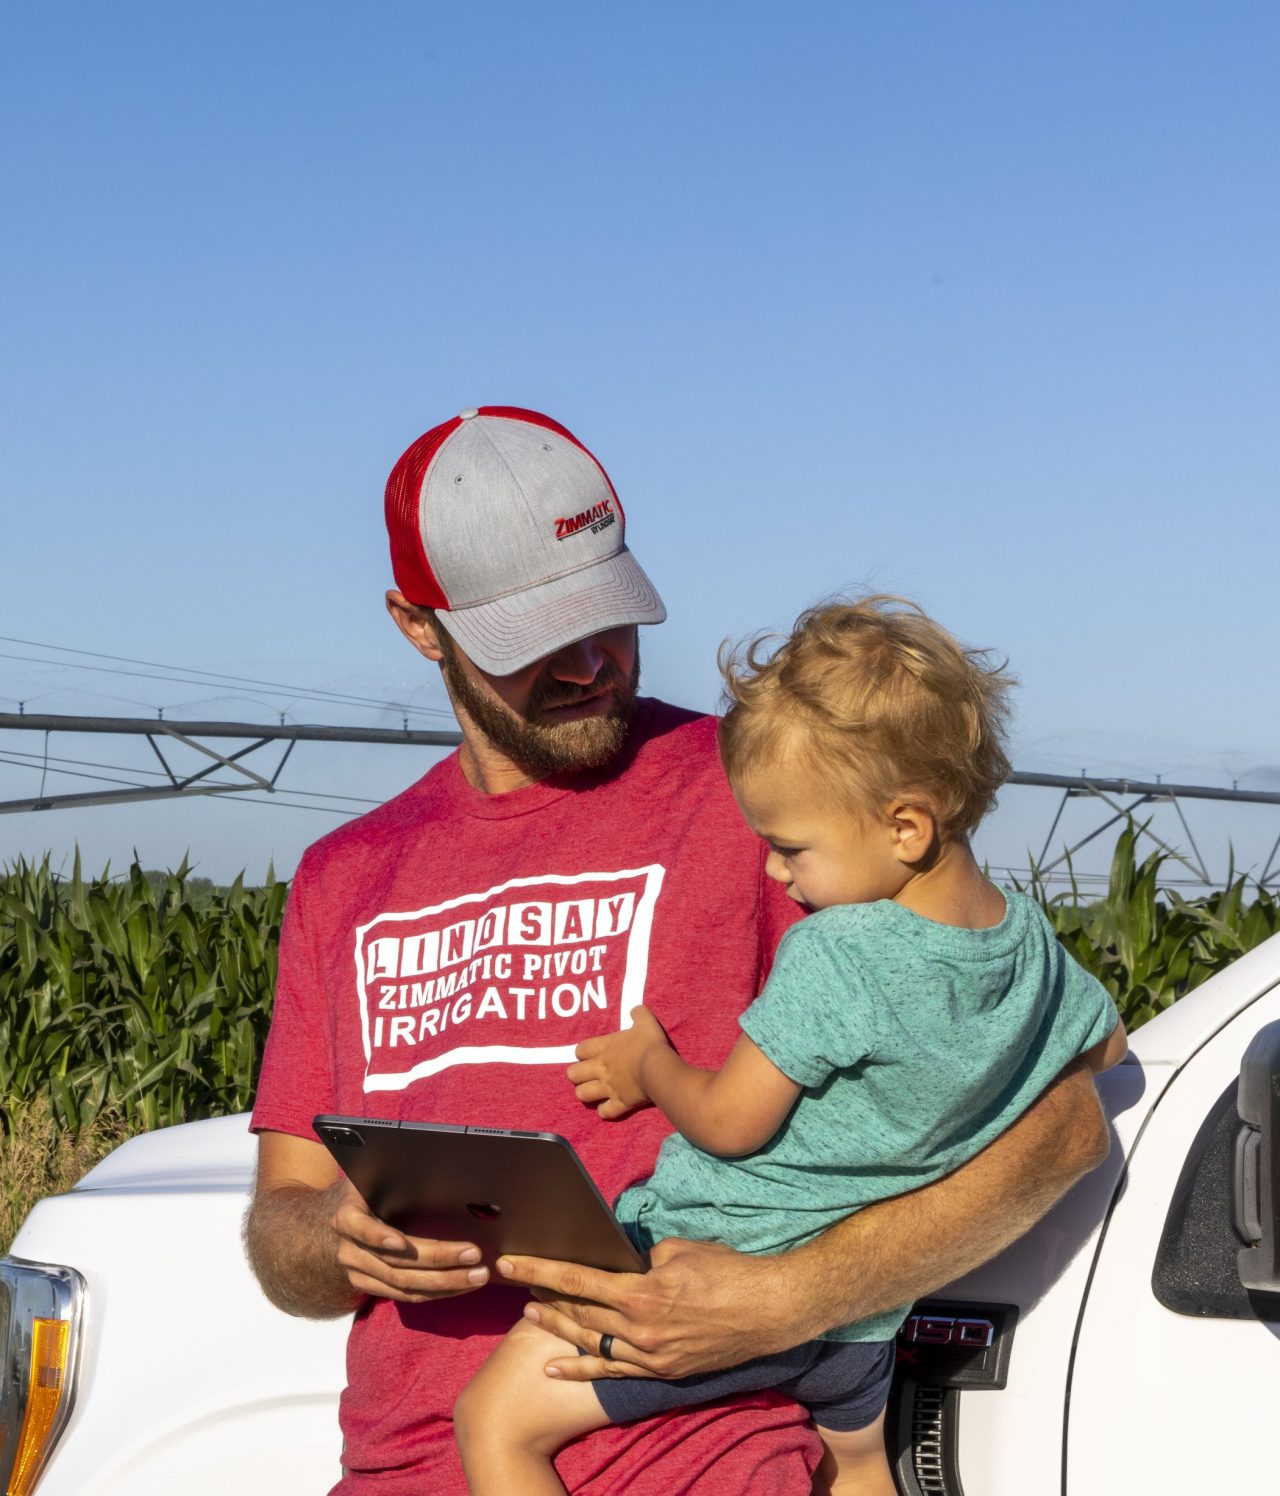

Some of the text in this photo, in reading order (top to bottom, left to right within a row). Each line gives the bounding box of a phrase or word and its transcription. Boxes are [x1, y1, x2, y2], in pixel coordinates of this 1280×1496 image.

[367, 892, 636, 985] LINDSAY
[374, 975, 608, 1048] IRRIGATION
[378, 945, 608, 1010] ZIMMATIC PIVOT
